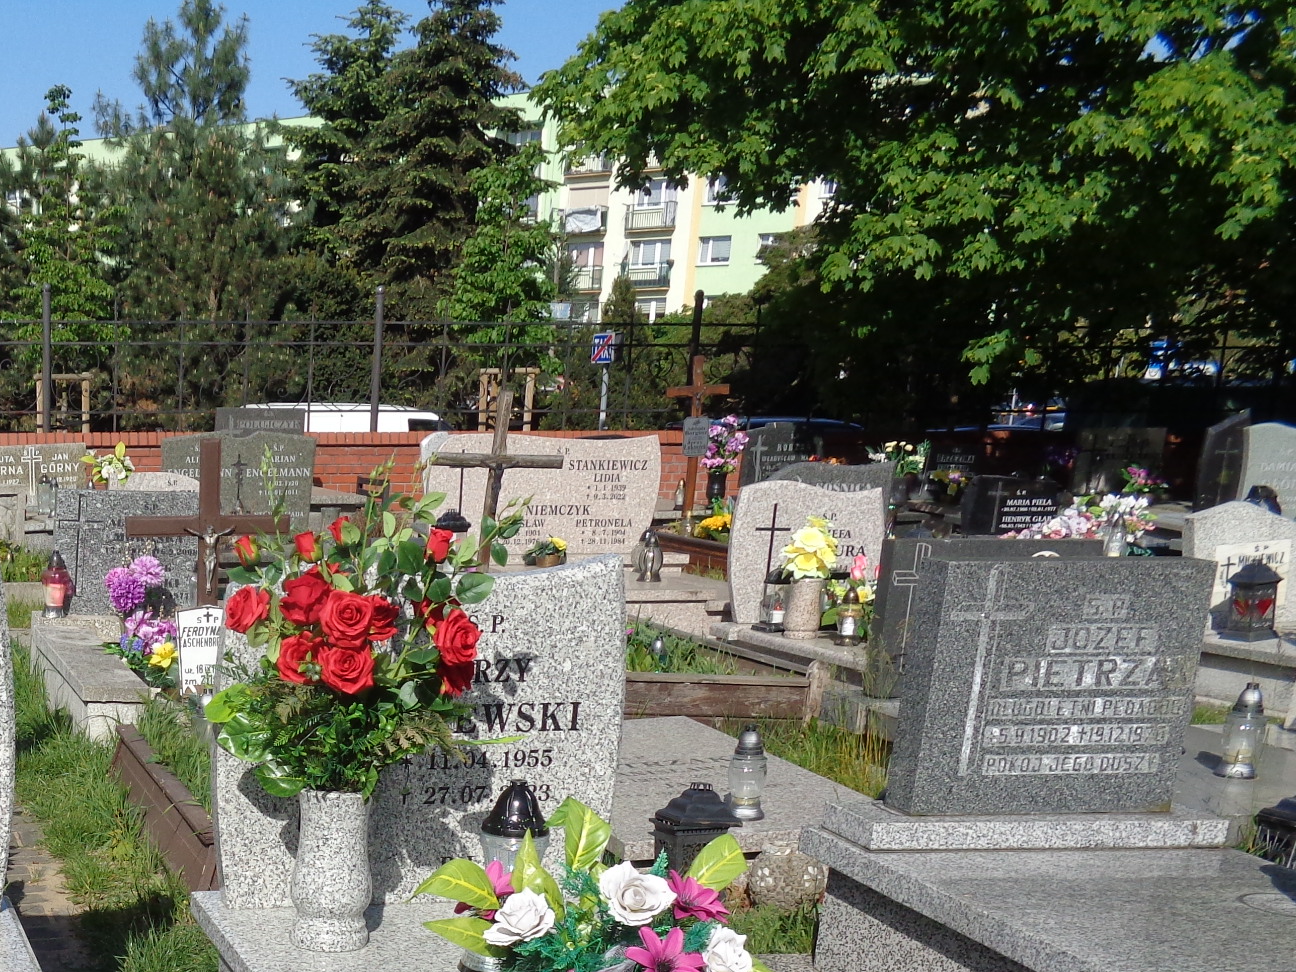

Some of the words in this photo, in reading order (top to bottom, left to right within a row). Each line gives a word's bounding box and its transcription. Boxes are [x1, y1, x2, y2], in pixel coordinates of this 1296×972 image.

[40, 462, 80, 473] GÓRNY
[568, 459, 648, 471] STANKIEWICZ
[593, 473, 621, 482] LIDIA
[526, 505, 590, 515] NIEMCZYK
[520, 519, 546, 528] SŁAW
[576, 519, 632, 528] PETRONELA
[492, 615, 505, 634] P.
[473, 658, 533, 683] RZY
[428, 749, 553, 770] 11.04.1955
[1049, 754, 1094, 772] JEGO
